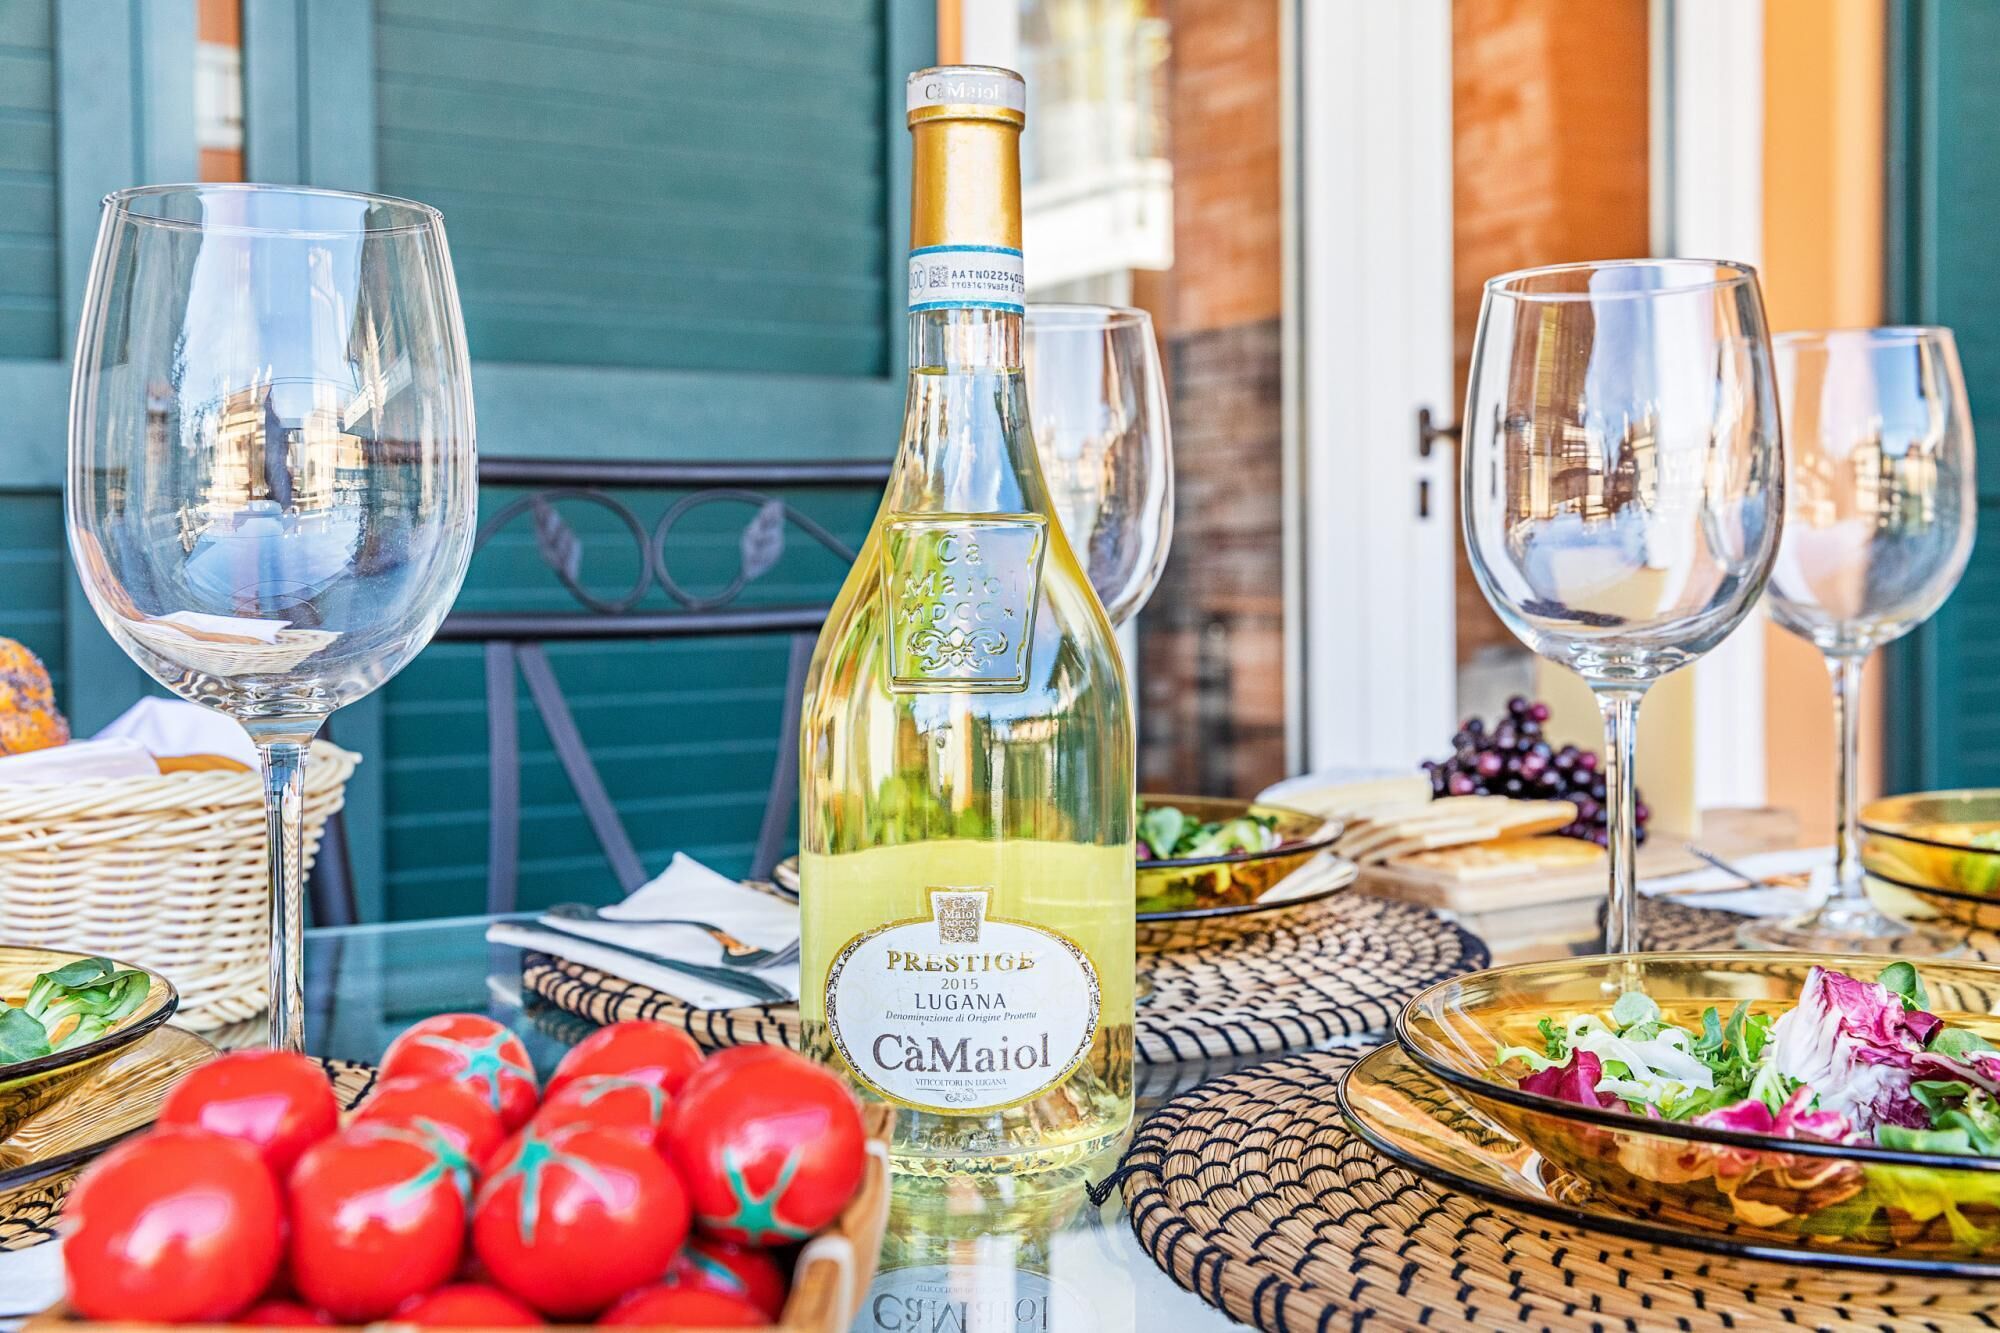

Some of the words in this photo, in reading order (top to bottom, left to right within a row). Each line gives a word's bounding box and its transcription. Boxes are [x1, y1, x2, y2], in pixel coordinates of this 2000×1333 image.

[936, 532, 983, 566] Cà
[900, 569, 1017, 599] Maiol
[944, 909, 977, 919] Maiol
[887, 950, 1035, 972] PRESTIGE
[941, 978, 979, 990] 2015
[914, 992, 1007, 1011] LUGANA
[885, 1010, 954, 1023] Denominazione
[955, 1013, 965, 1023] di
[967, 1012, 1001, 1024] Origine
[1003, 1011, 1037, 1021] Protetta
[872, 1032, 1052, 1073] CàMaiol
[915, 1078, 963, 1086] VITICOLTORI
[964, 1079, 974, 1087] IN
[975, 1078, 1007, 1086] LUGANA
